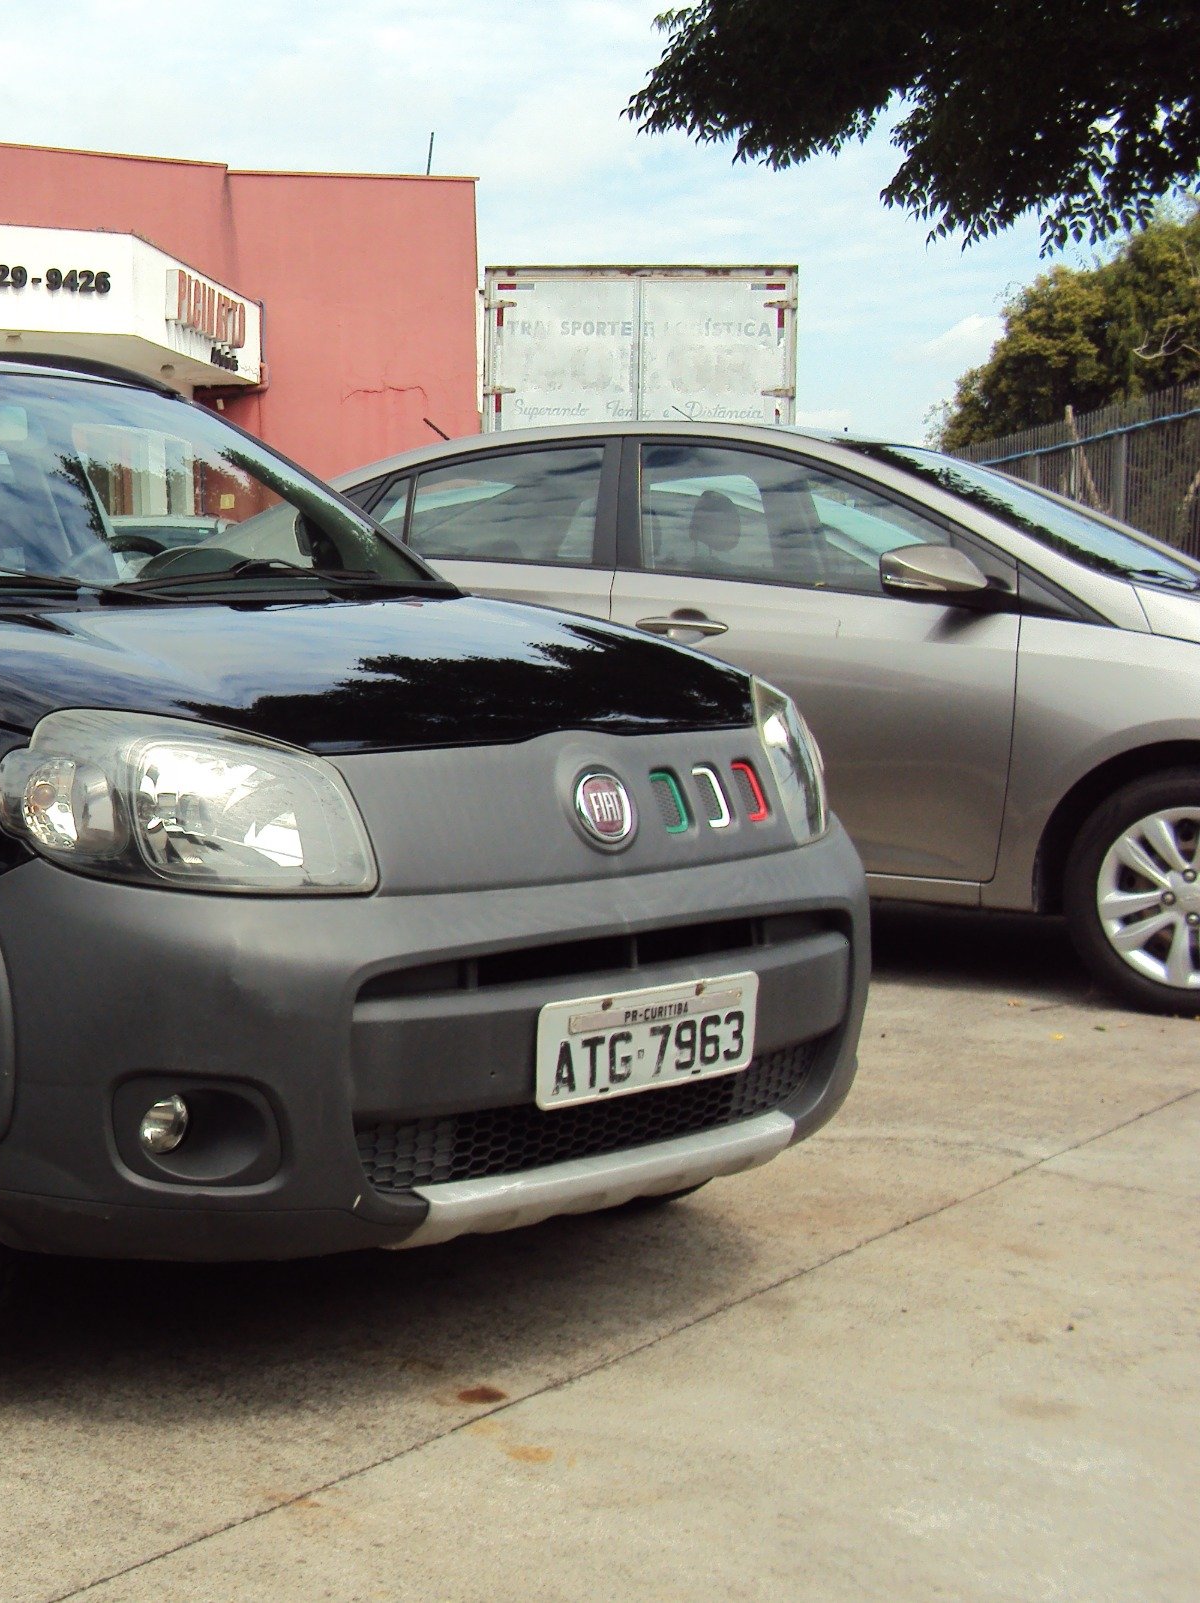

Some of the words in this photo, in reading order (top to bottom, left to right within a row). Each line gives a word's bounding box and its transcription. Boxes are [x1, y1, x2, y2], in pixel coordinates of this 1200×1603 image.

[515, 399, 589, 419] Superando
[589, 791, 622, 823] FIAT
[624, 1001, 689, 1022] PR-CURITIBA
